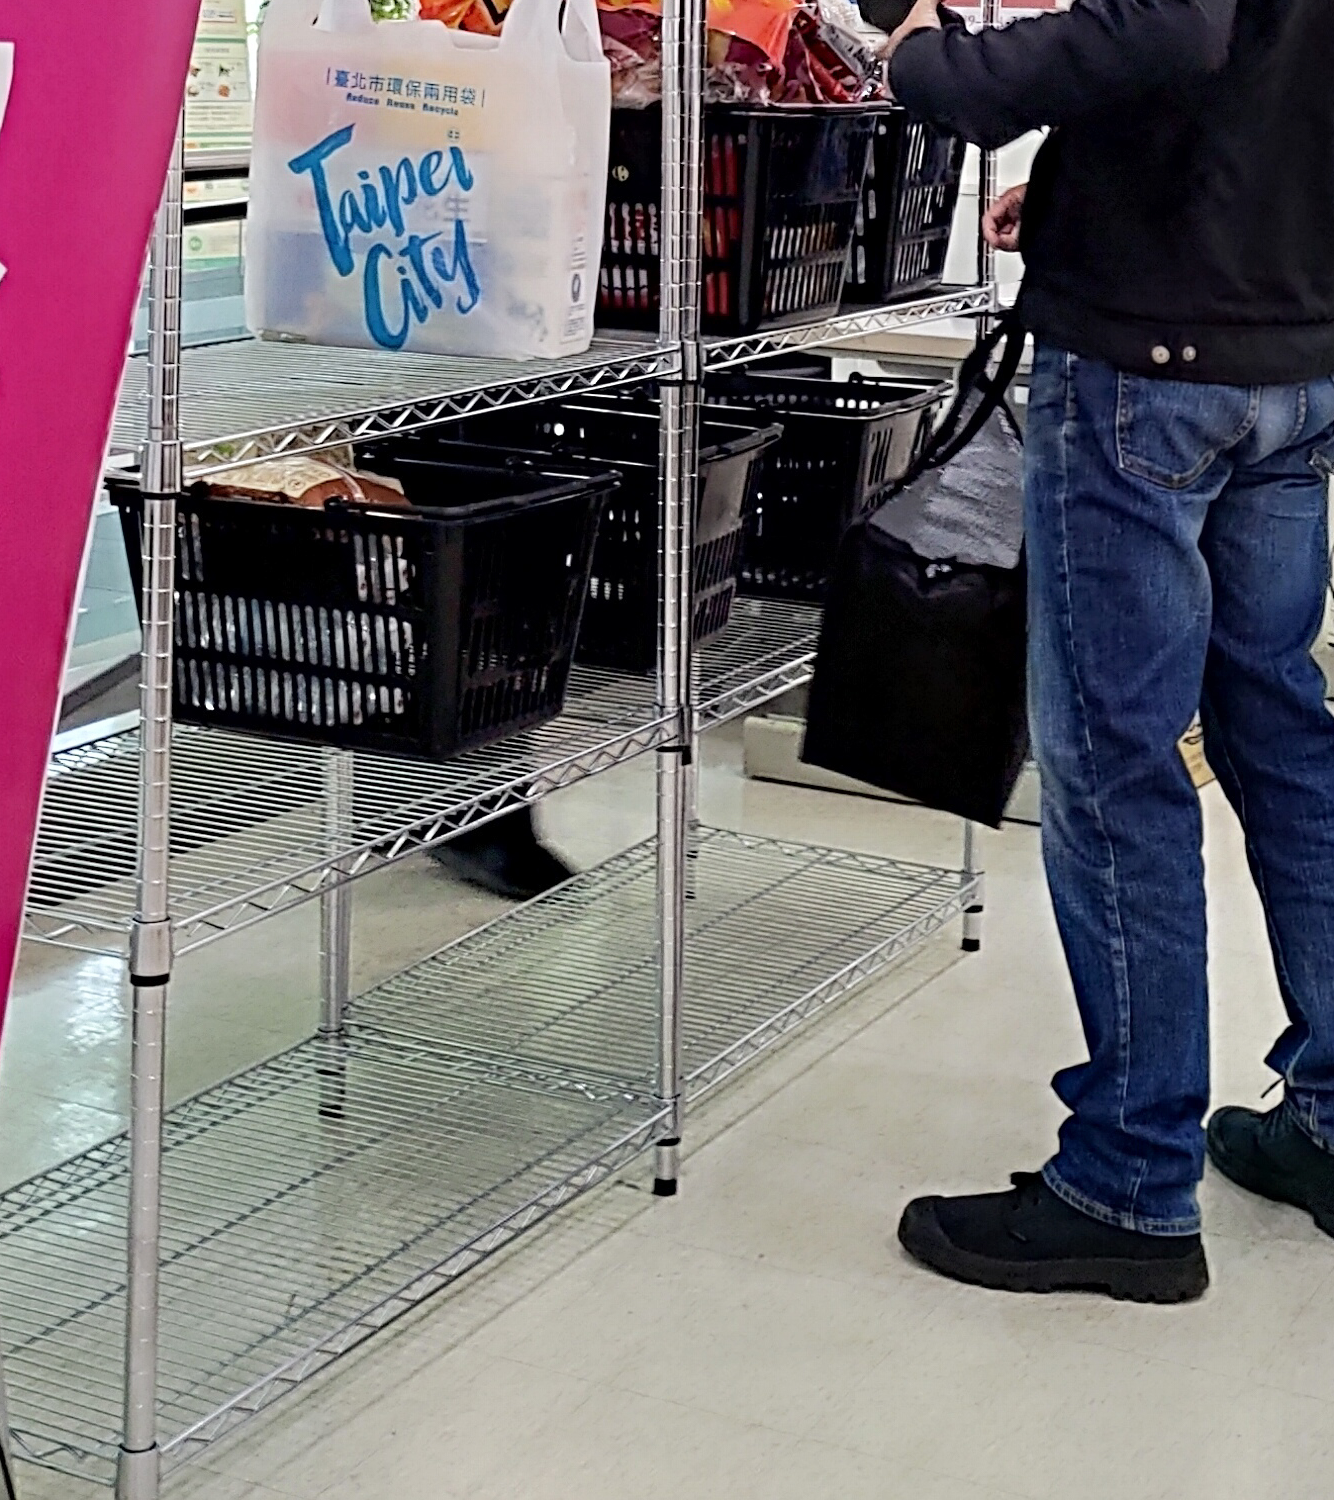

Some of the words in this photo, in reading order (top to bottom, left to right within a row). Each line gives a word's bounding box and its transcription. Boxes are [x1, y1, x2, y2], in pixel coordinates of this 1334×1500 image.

[335, 69, 477, 106] 臺北市環保兩用袋
[288, 123, 474, 277] Taipei
[364, 219, 481, 351] City
